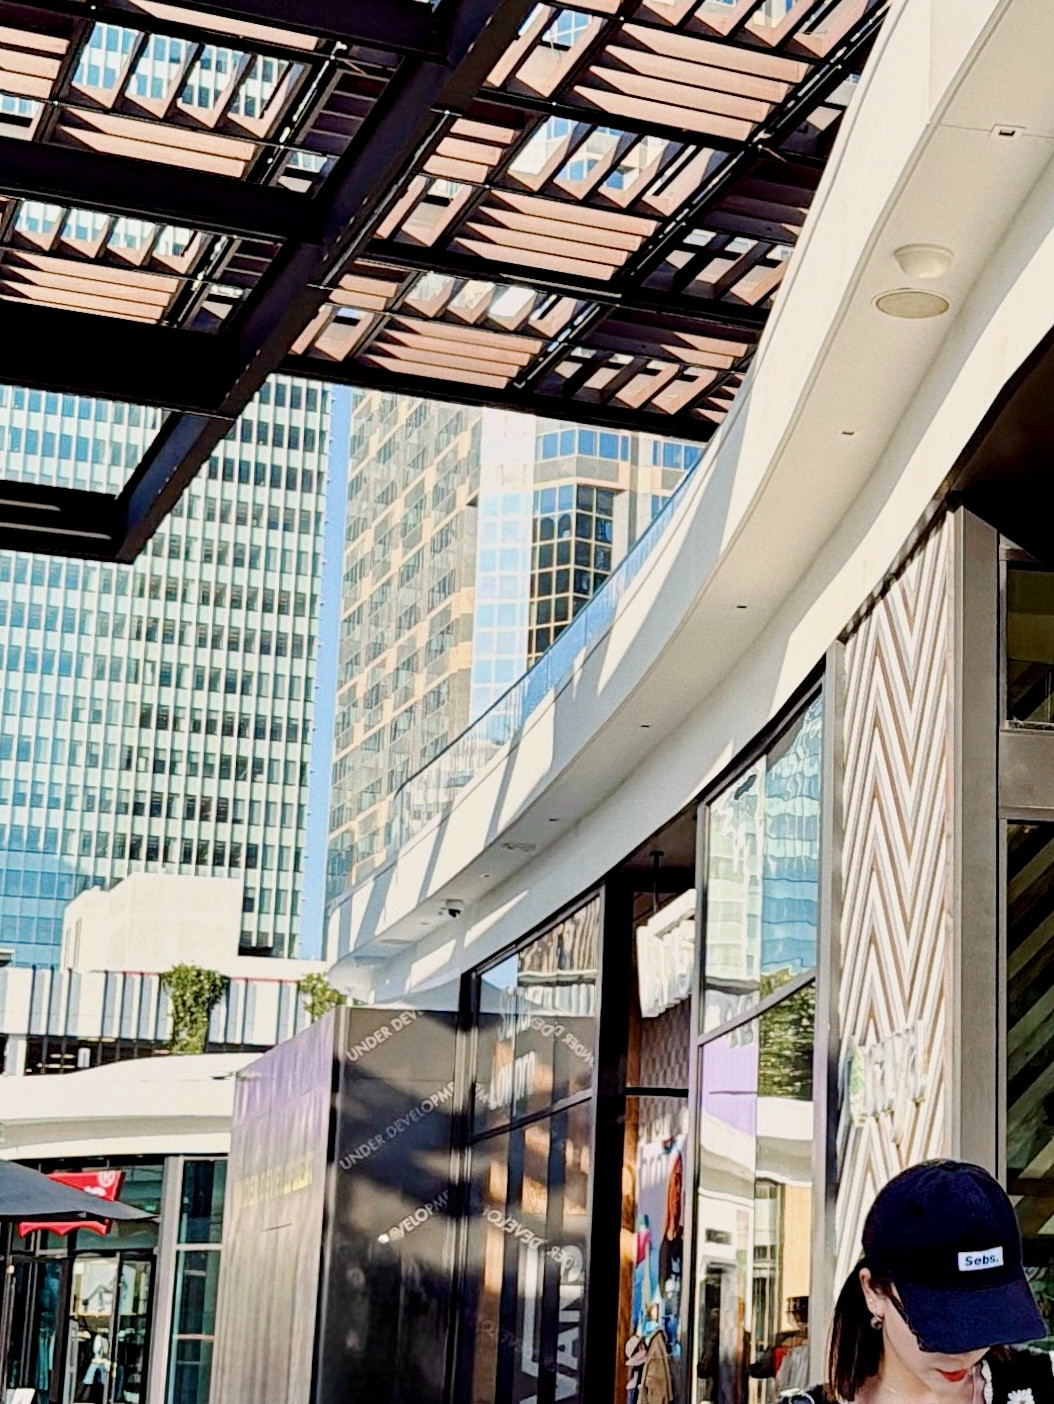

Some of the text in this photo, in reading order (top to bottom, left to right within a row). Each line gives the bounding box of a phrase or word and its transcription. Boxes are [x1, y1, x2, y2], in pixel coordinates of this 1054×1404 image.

[345, 1010, 424, 1062] UNDER DEV
[339, 1133, 386, 1171] UNDER
[964, 1254, 1000, 1267] Sebs.
